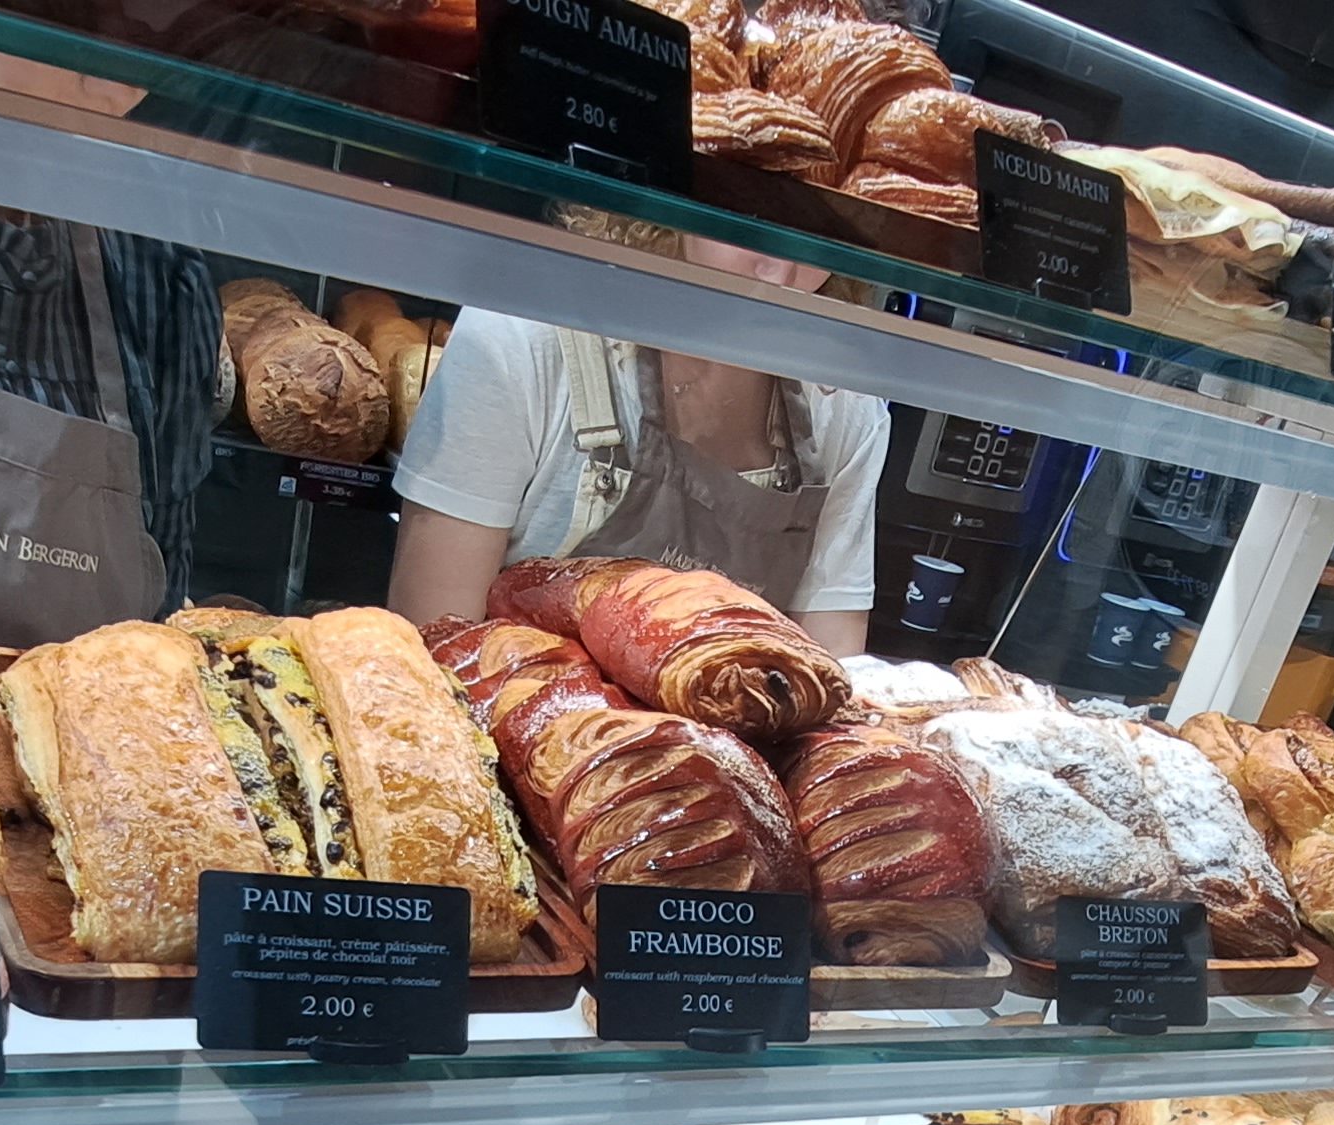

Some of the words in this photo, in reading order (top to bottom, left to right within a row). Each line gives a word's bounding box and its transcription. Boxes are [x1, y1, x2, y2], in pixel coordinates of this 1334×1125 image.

[509, 0, 590, 32] UIGN
[599, 16, 688, 70] AMANN
[567, 97, 605, 128] 2.80
[609, 116, 617, 133] €
[993, 149, 1051, 185] NŒUD
[1056, 171, 1109, 204] MARIN
[1038, 251, 1067, 274] 2.00
[1071, 264, 1079, 277] €
[242, 887, 312, 914] PAIN
[324, 893, 434, 922] SUISSE
[659, 899, 754, 924] CHOCO
[1086, 904, 1180, 925] CHAUSSON
[223, 932, 254, 946] pâte
[258, 934, 267, 944] à
[270, 935, 337, 949] croissant,
[341, 939, 381, 951] crème
[629, 930, 783, 958] FRAMBOISE
[1099, 925, 1168, 944] BRETON
[259, 947, 309, 962] pépites
[312, 949, 328, 961] de
[332, 951, 388, 964] chocolat
[391, 954, 418, 965] noir
[231, 970, 283, 981] croissant
[287, 971, 311, 982] with
[313, 973, 350, 986] pastry
[391, 976, 442, 987] chocolate
[605, 970, 654, 981] croissant
[656, 971, 680, 982] with
[683, 973, 733, 985] raspberry
[736, 975, 756, 984] and
[758, 975, 804, 985] chocolate
[301, 995, 355, 1017] 2.00
[363, 1003, 374, 1018] €
[682, 994, 720, 1013] 2.00
[724, 999, 733, 1013] €
[1114, 988, 1144, 1004] 2.00
[1148, 992, 1155, 1003] €
